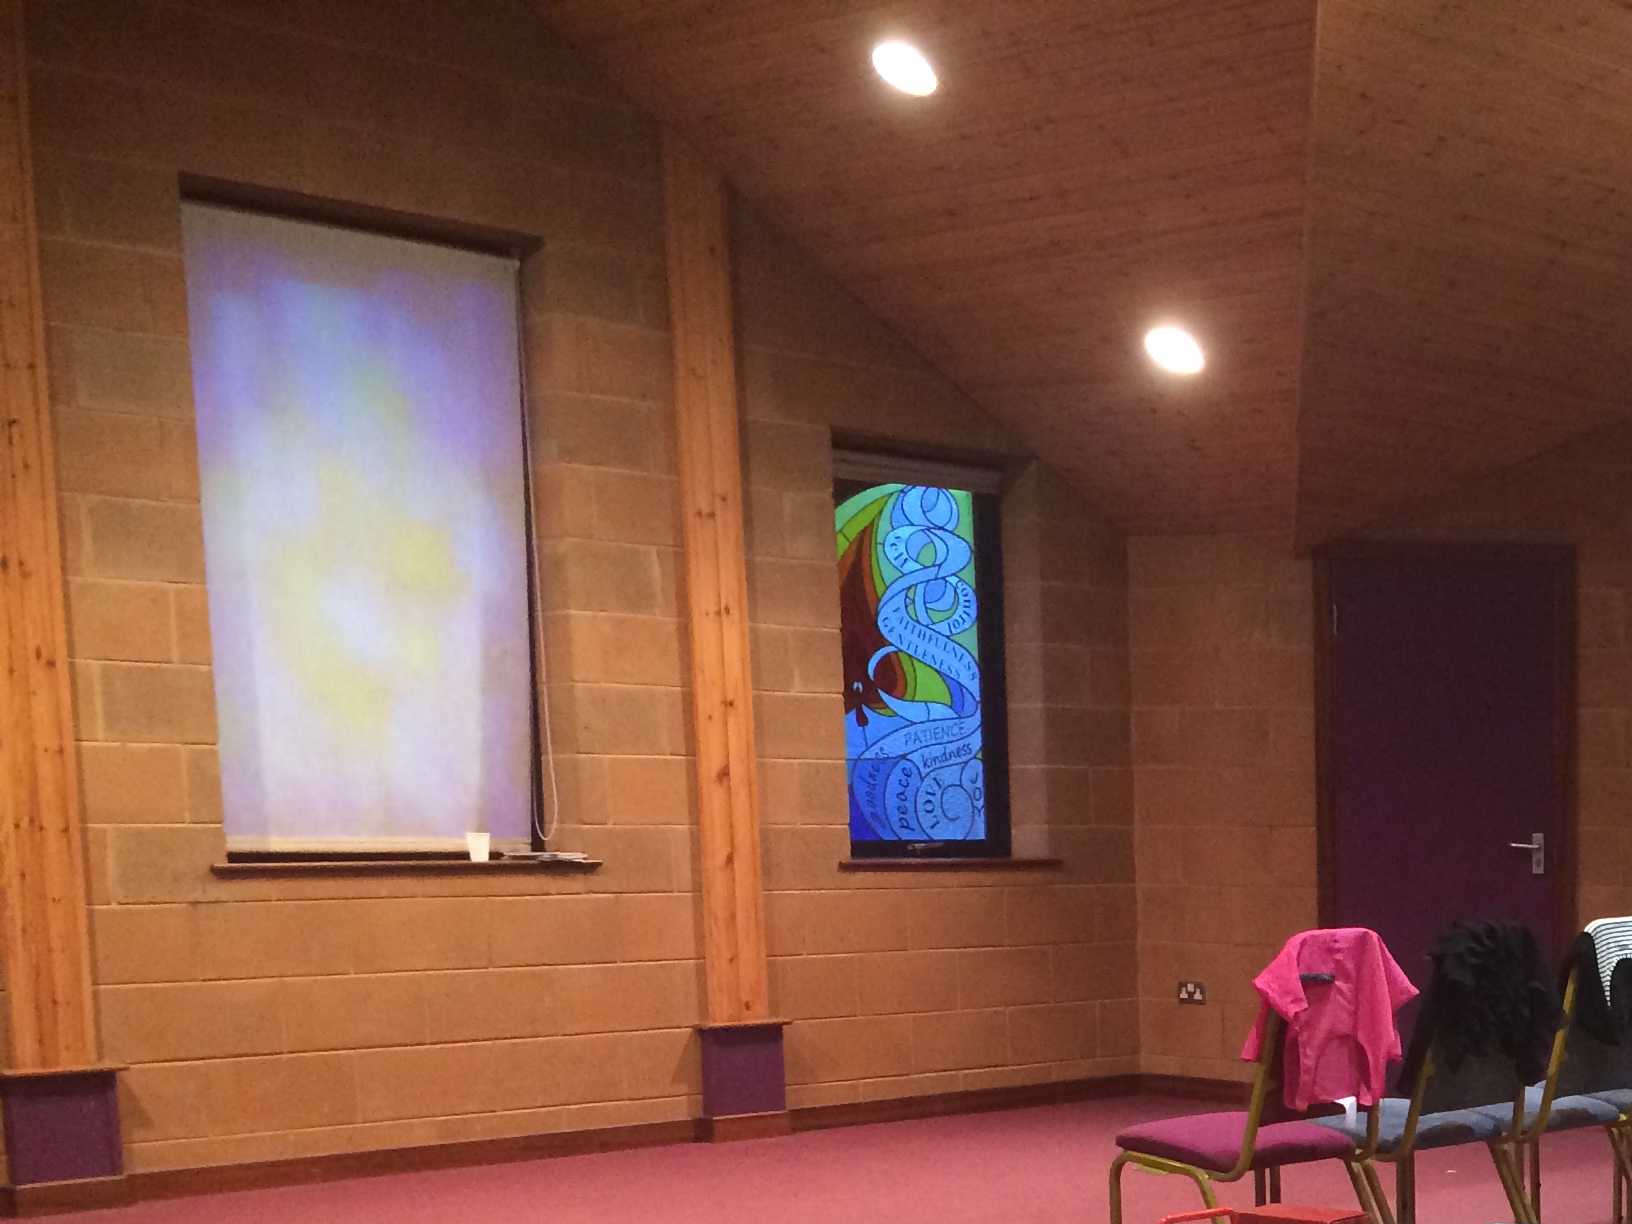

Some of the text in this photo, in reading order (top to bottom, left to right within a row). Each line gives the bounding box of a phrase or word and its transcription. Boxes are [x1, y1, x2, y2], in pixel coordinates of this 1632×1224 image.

[890, 534, 911, 569] self
[946, 579, 973, 634] control
[882, 616, 961, 679] GENTLENESS
[892, 606, 978, 682] FAITHFULNESS
[903, 722, 966, 748] PATIENCE
[920, 742, 973, 770] kindness
[896, 766, 916, 831] peace
[923, 775, 944, 829] LOVE
[969, 771, 985, 818] JOY
